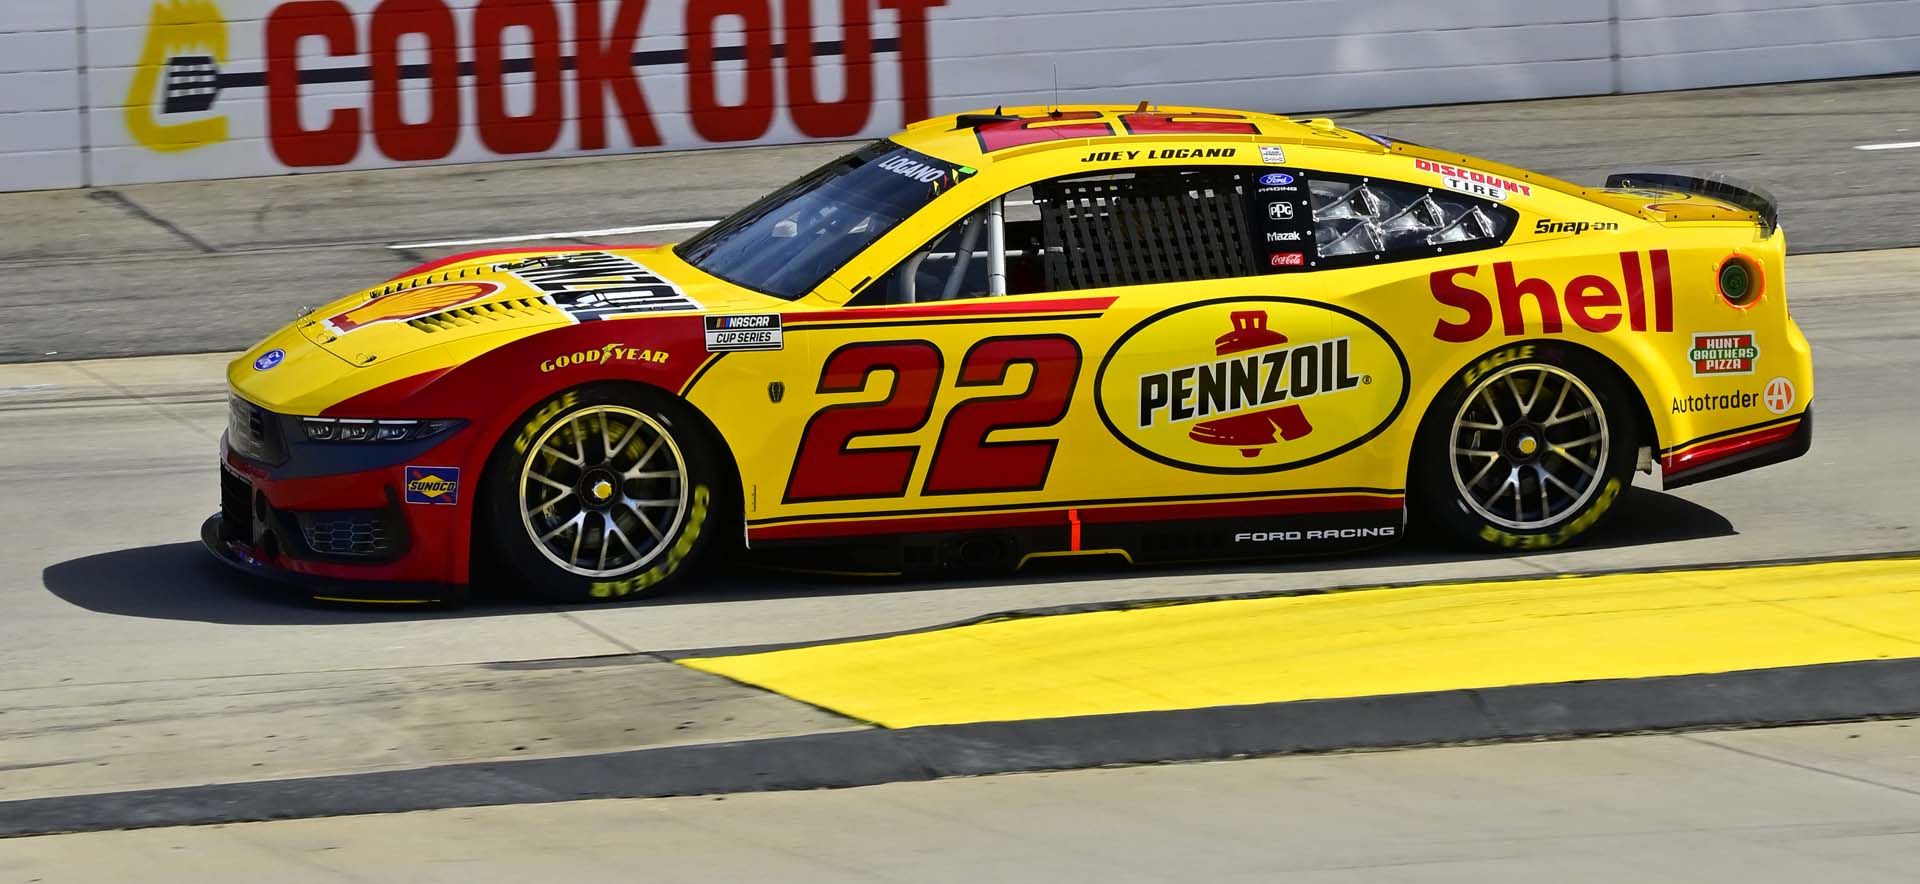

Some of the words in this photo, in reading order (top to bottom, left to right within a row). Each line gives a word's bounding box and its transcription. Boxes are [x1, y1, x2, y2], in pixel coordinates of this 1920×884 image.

[265, 0, 663, 168] COOK
[686, 0, 950, 142] OUT
[1081, 151, 1140, 163] JOEY
[1148, 148, 1237, 160] LOGANO
[878, 155, 945, 183] LOGANO
[1415, 158, 1531, 197] DISCOUNT
[1449, 179, 1500, 198] TIRE
[1269, 203, 1293, 219] PPG
[1534, 218, 1619, 235] Snap-on
[1267, 231, 1301, 242] Mazak
[1428, 249, 1674, 343] Shell
[729, 316, 770, 328] NASCAR
[716, 333, 736, 343] CUP
[737, 332, 772, 342] SERIES
[1706, 337, 1740, 349] HUNT
[1693, 348, 1754, 360] BROTHERS
[1706, 359, 1741, 370] PIZZA
[1139, 337, 1360, 428] PENNZOIL
[1671, 389, 1759, 414] Autotrader
[780, 333, 1084, 505] 22
[408, 481, 456, 492] SUNOCO
[1235, 531, 1301, 542] FORD
[1306, 527, 1395, 540] RACING
